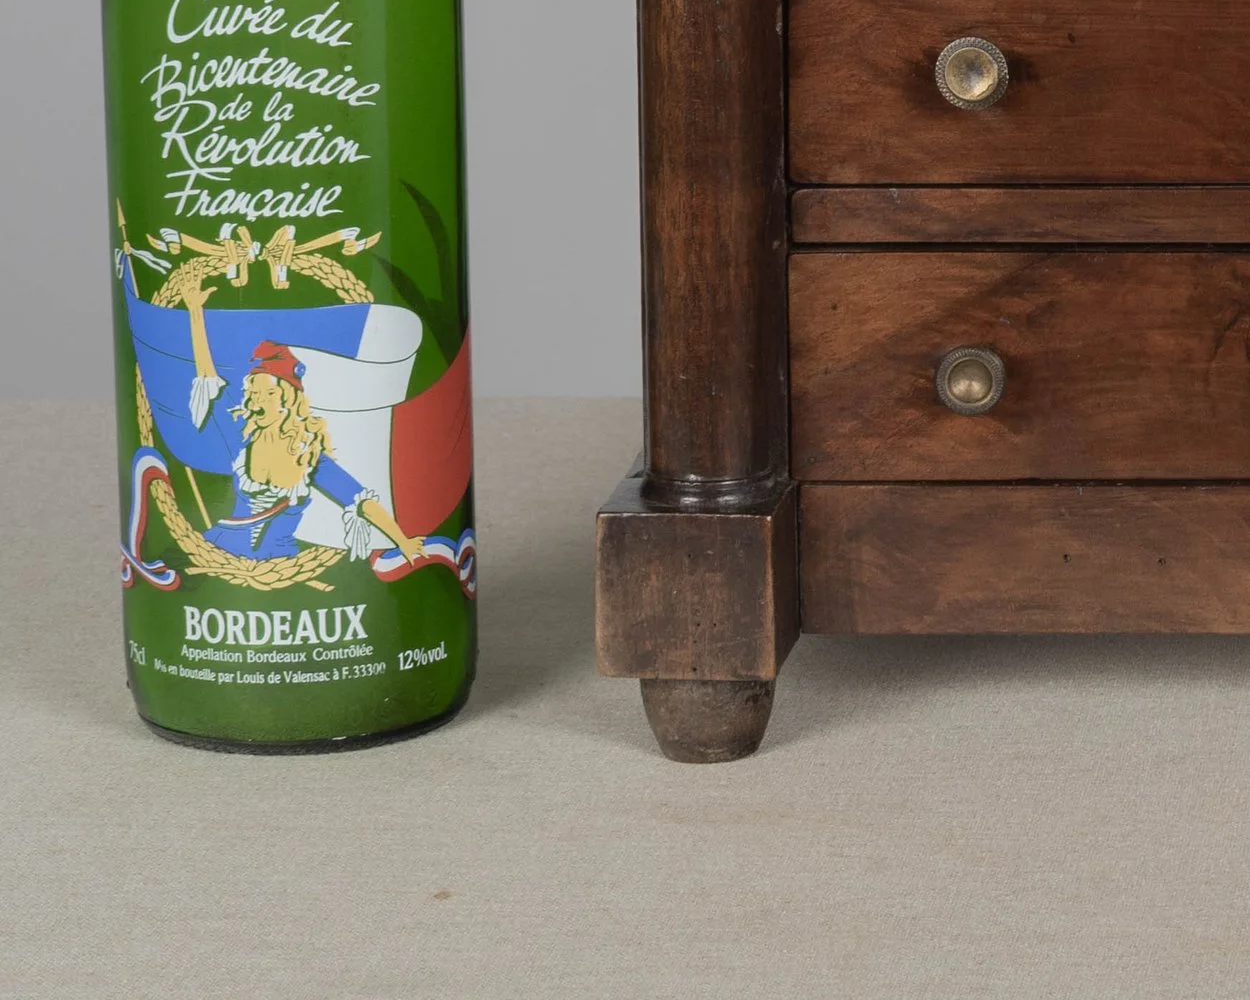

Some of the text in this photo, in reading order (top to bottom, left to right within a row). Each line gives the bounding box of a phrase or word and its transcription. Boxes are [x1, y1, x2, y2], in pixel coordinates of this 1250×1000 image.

[291, 1, 352, 46] du
[140, 48, 381, 108] Bicentenaire
[218, 92, 294, 122] de la
[154, 100, 371, 181] Révolution
[164, 167, 344, 222] Française
[183, 604, 369, 645] BORDEAUX
[168, 665, 179, 676] en
[179, 664, 216, 681] bouteille
[218, 672, 234, 685] par
[236, 671, 265, 684] Louis
[267, 671, 281, 684] de
[283, 671, 331, 683] Valensac
[333, 668, 340, 680] à
[181, 643, 374, 663] Appellation Bordeaux Contrôlée
